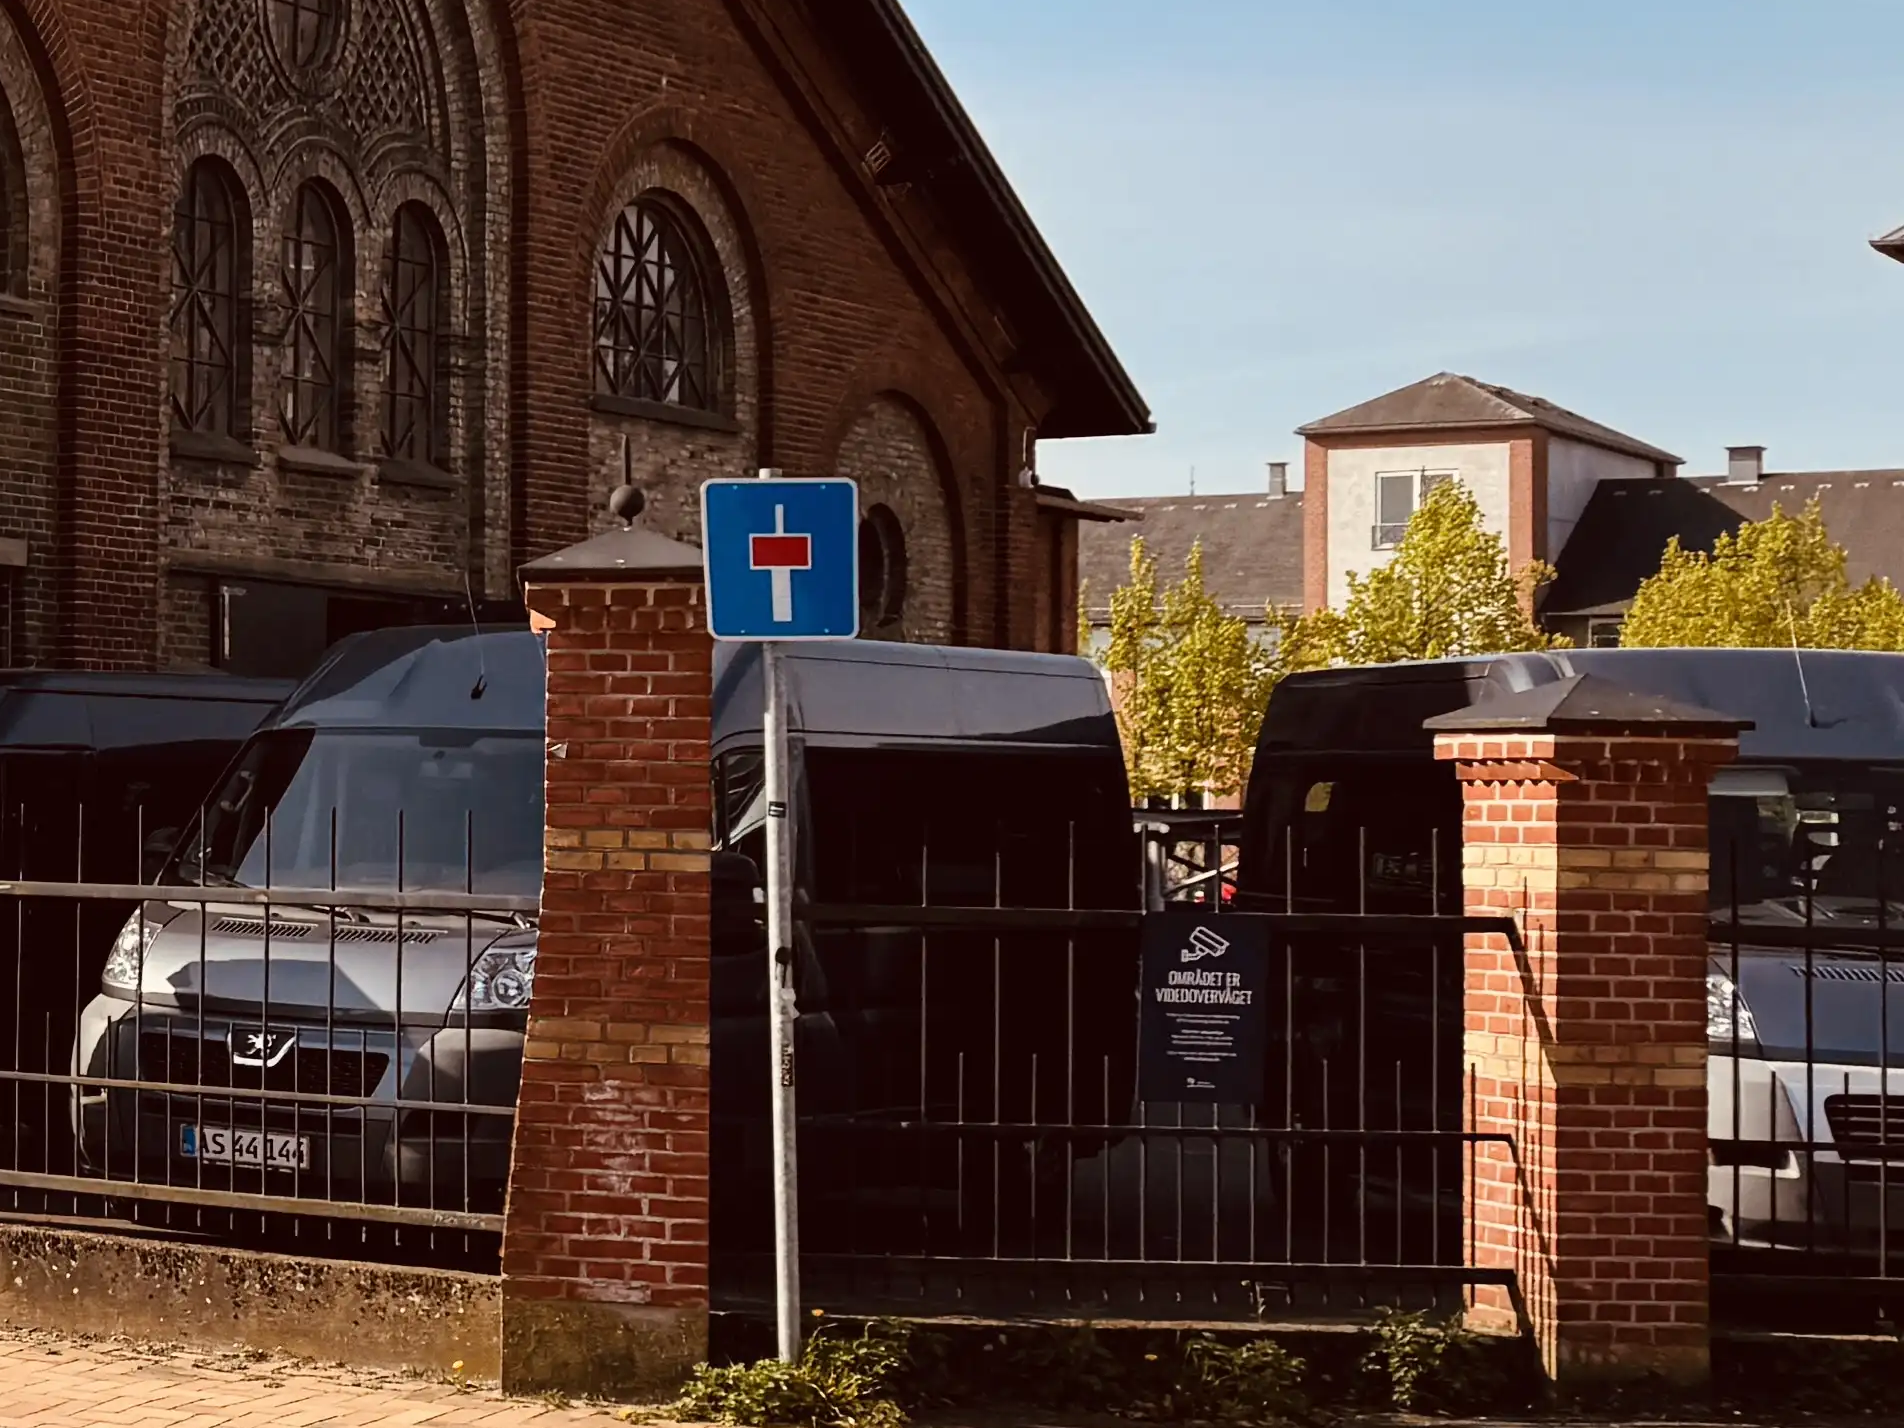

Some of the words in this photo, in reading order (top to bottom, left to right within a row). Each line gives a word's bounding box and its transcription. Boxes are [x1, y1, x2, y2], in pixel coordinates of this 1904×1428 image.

[1168, 968, 1223, 986] OMRÅDET
[1226, 972, 1241, 987] ER
[201, 1132, 226, 1155] AS
[233, 1135, 258, 1159] 44
